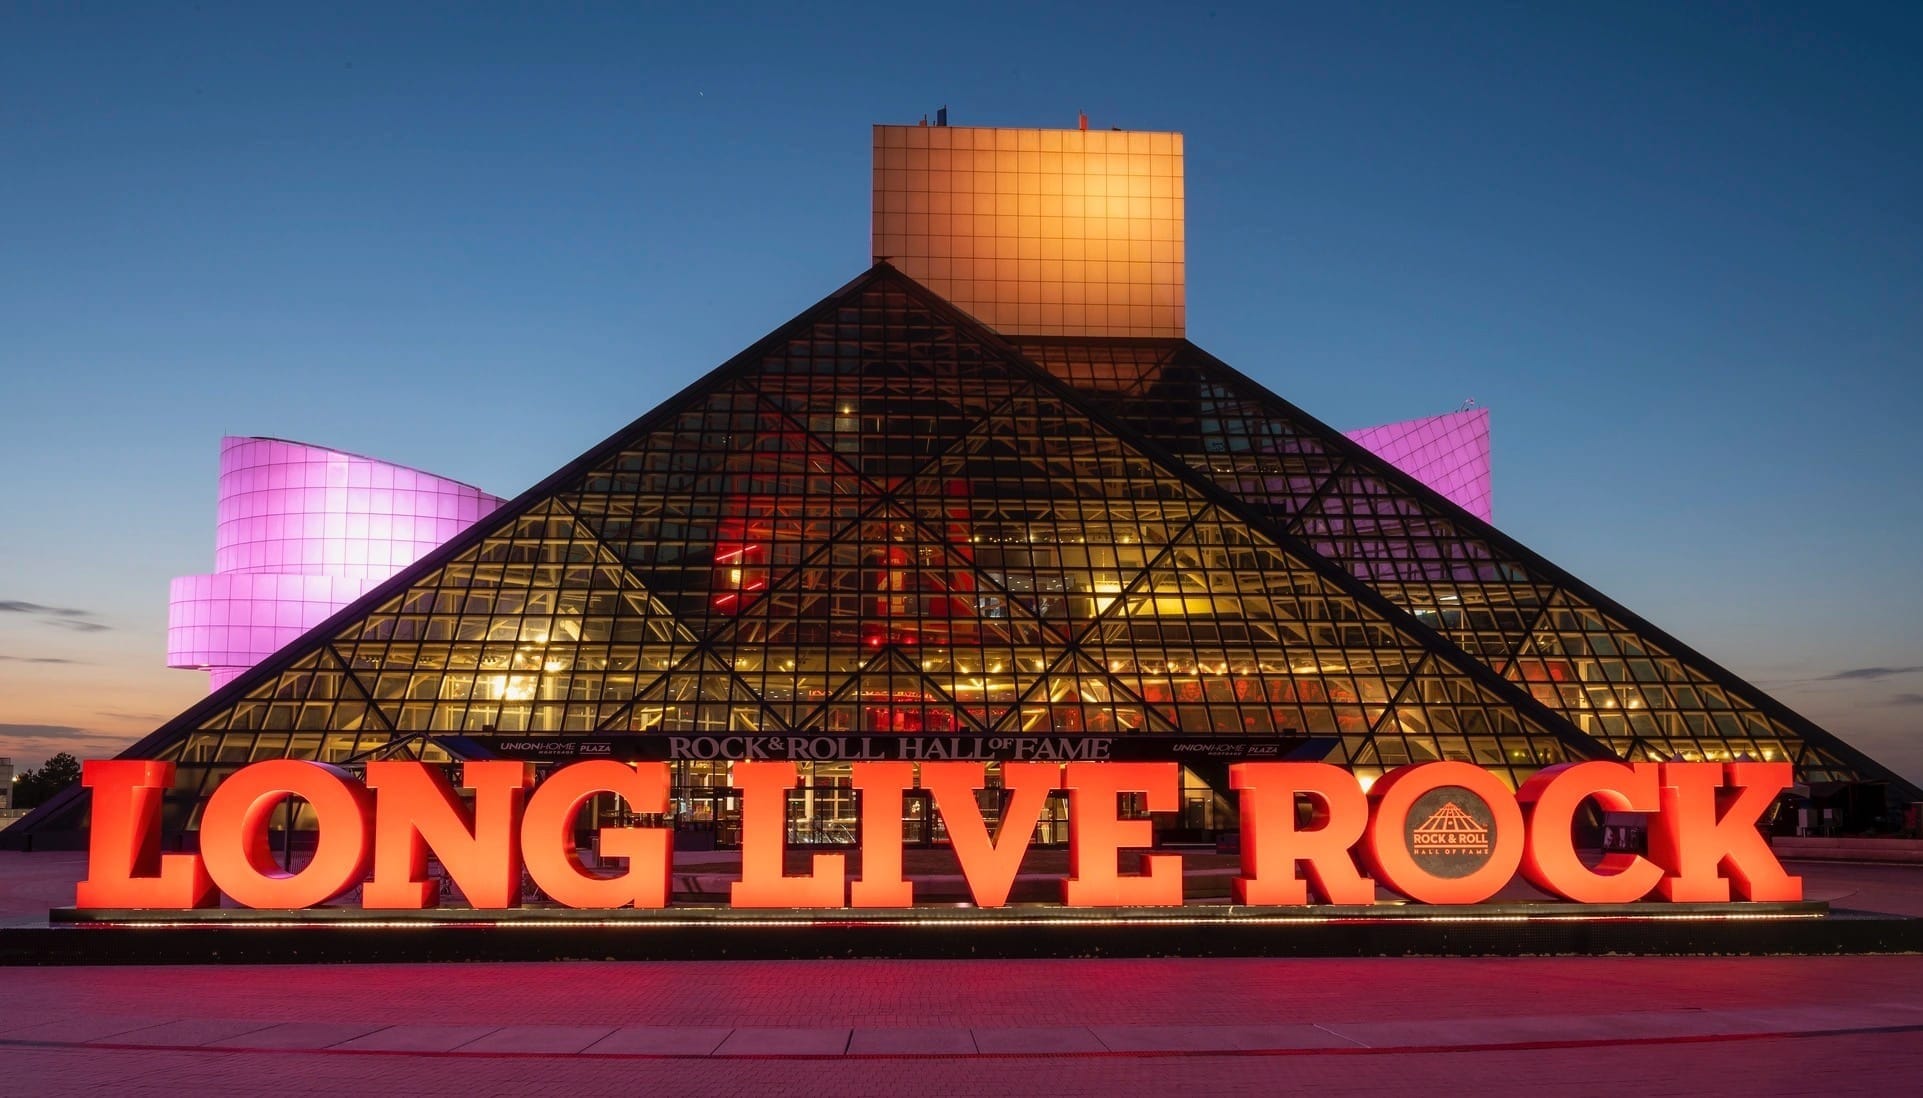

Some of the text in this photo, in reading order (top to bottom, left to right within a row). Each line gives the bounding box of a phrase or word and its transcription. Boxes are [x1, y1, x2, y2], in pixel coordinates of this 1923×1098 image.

[579, 744, 612, 753] PLAZA
[897, 737, 996, 760] HALL
[988, 737, 1014, 750] OF
[1014, 737, 1113, 760] FAME
[1248, 746, 1279, 754] PLAZA
[76, 759, 1804, 910] LONG LIVE ROCK
[1413, 833, 1488, 844] ROCK & ROLL
